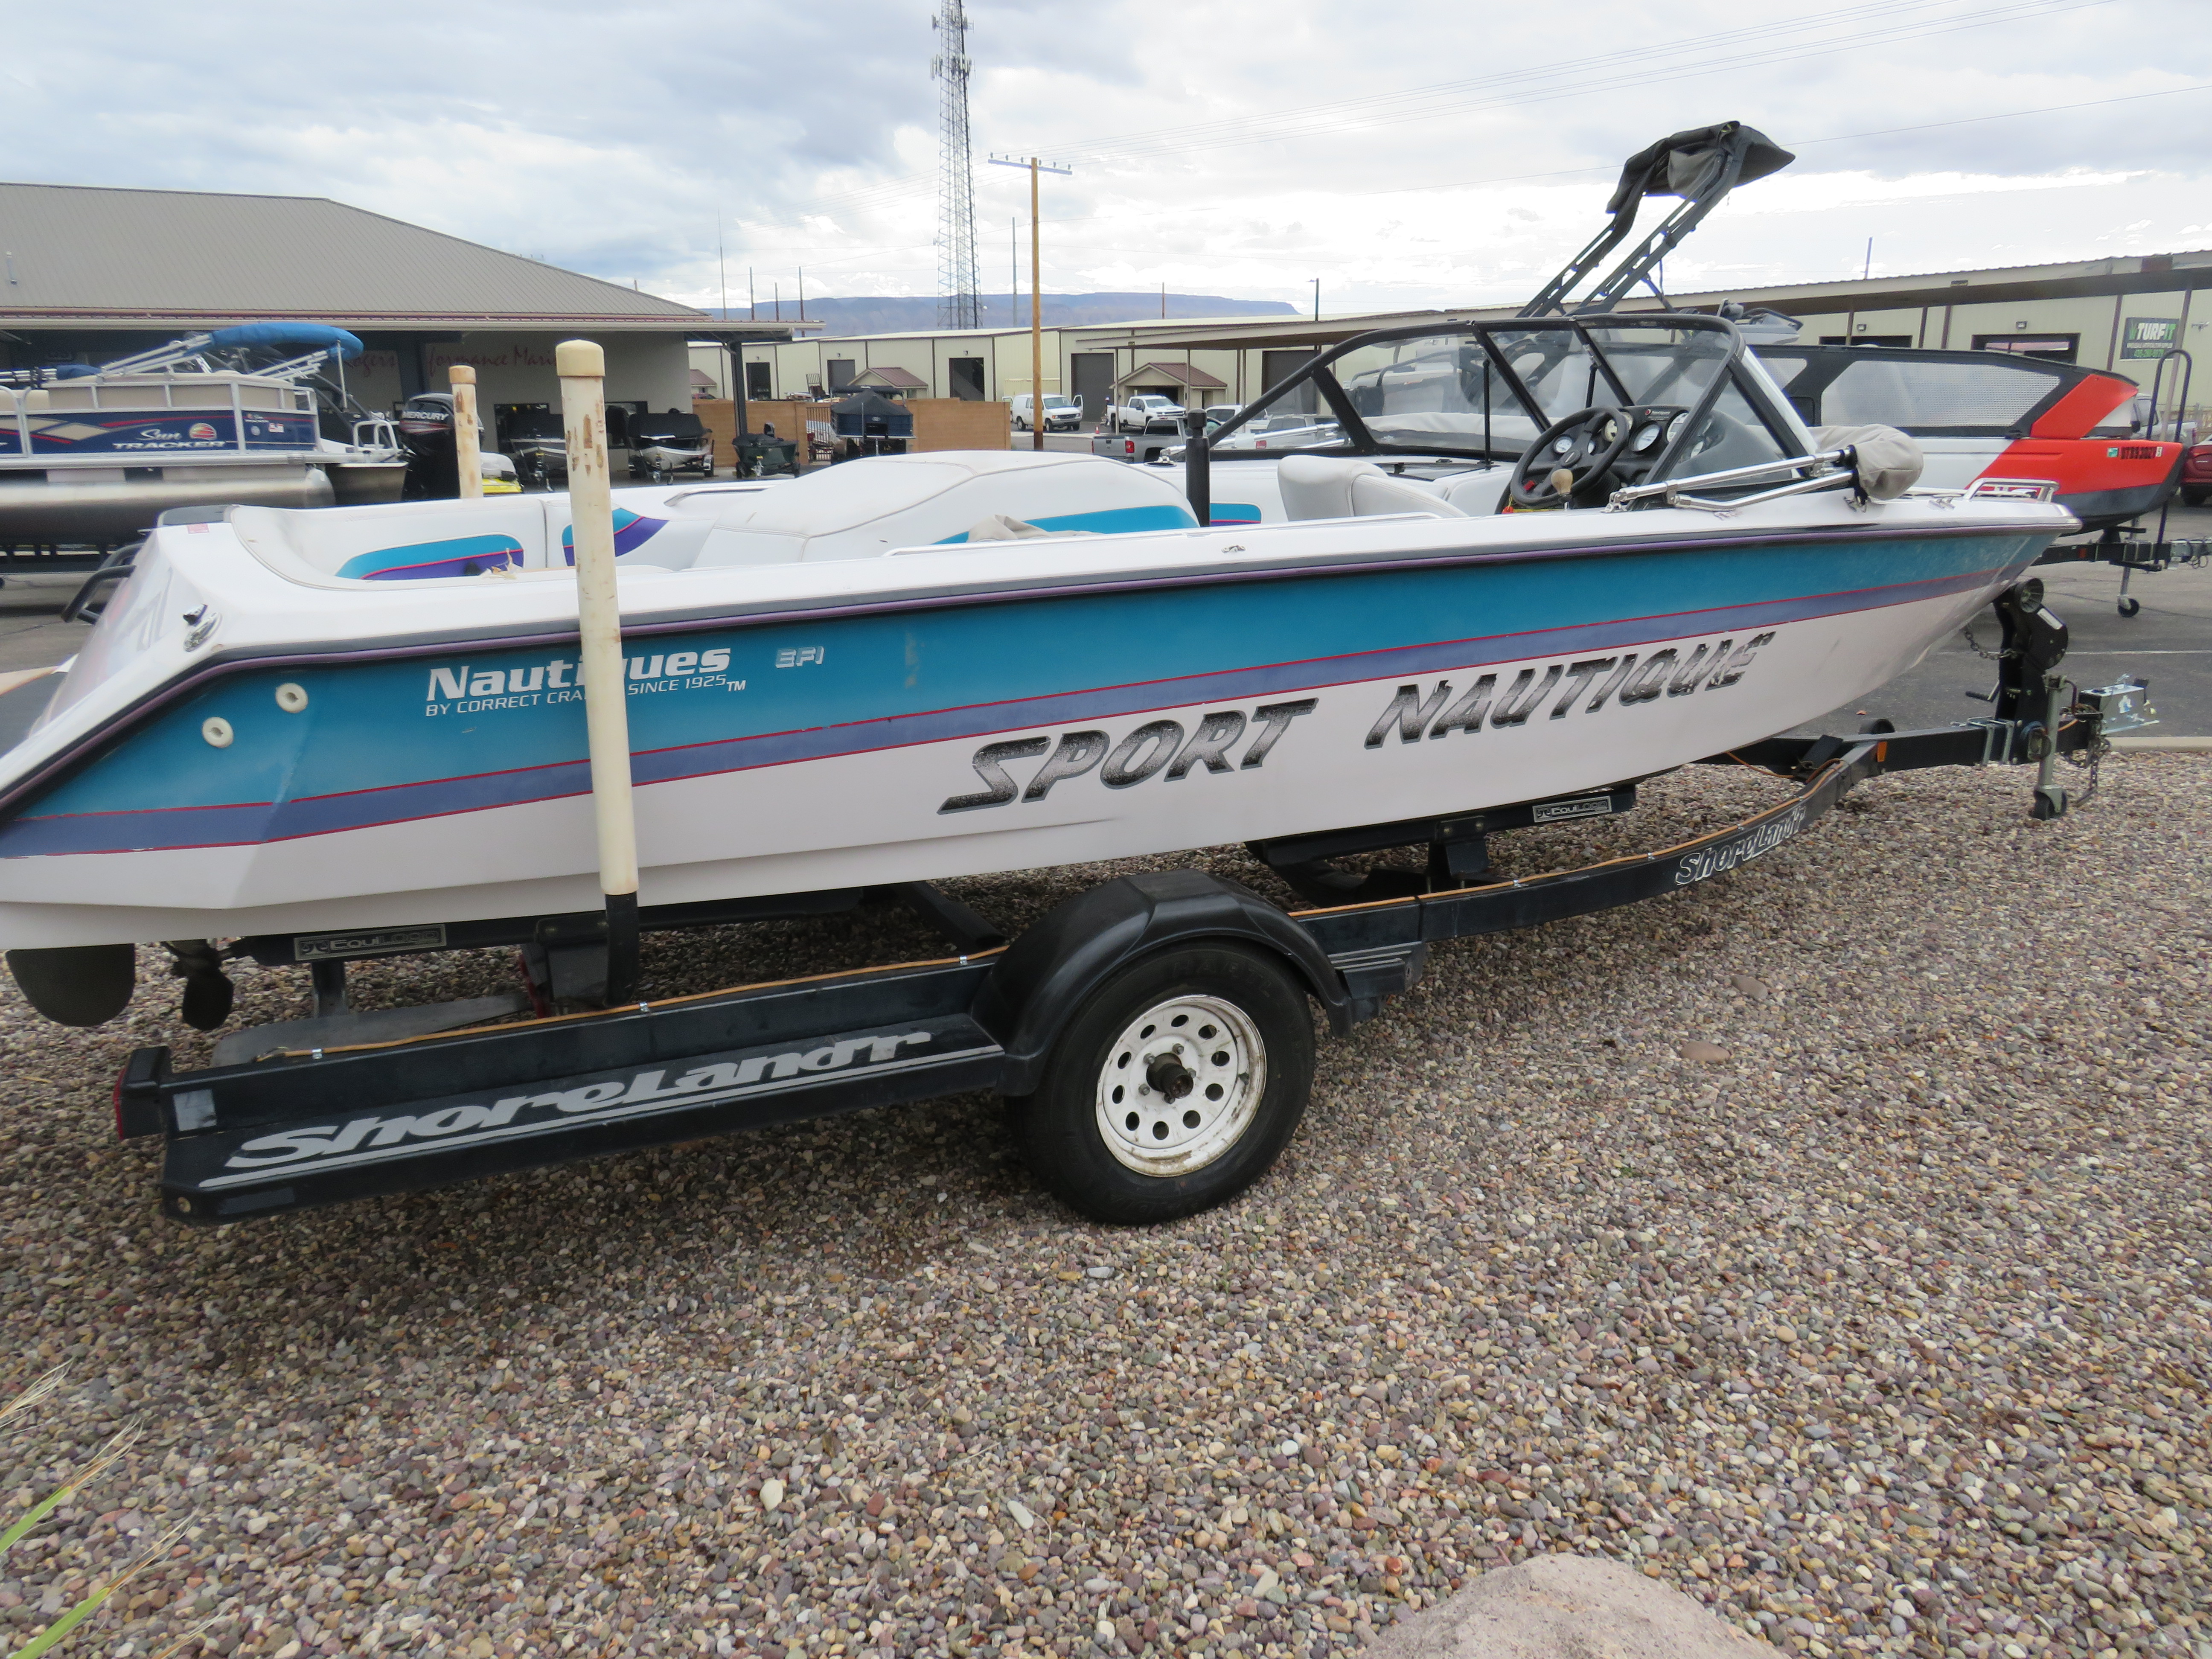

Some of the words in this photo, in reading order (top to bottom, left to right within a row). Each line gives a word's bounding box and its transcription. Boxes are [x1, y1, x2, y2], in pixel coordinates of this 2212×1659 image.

[514, 345, 556, 366] Mari
[402, 410, 449, 421] MERCURY
[112, 441, 226, 449] TRACKER
[136, 428, 182, 440] Sun
[775, 645, 825, 669] EFI
[426, 647, 731, 701] Nautiues
[425, 702, 451, 717] BY
[457, 693, 541, 713] CORRECT
[547, 689, 586, 705] CRA
[627, 679, 680, 696] SINCE
[685, 674, 728, 690] 1925
[936, 697, 1319, 815] SPORT
[1364, 631, 1776, 750] NAUTIQUE
